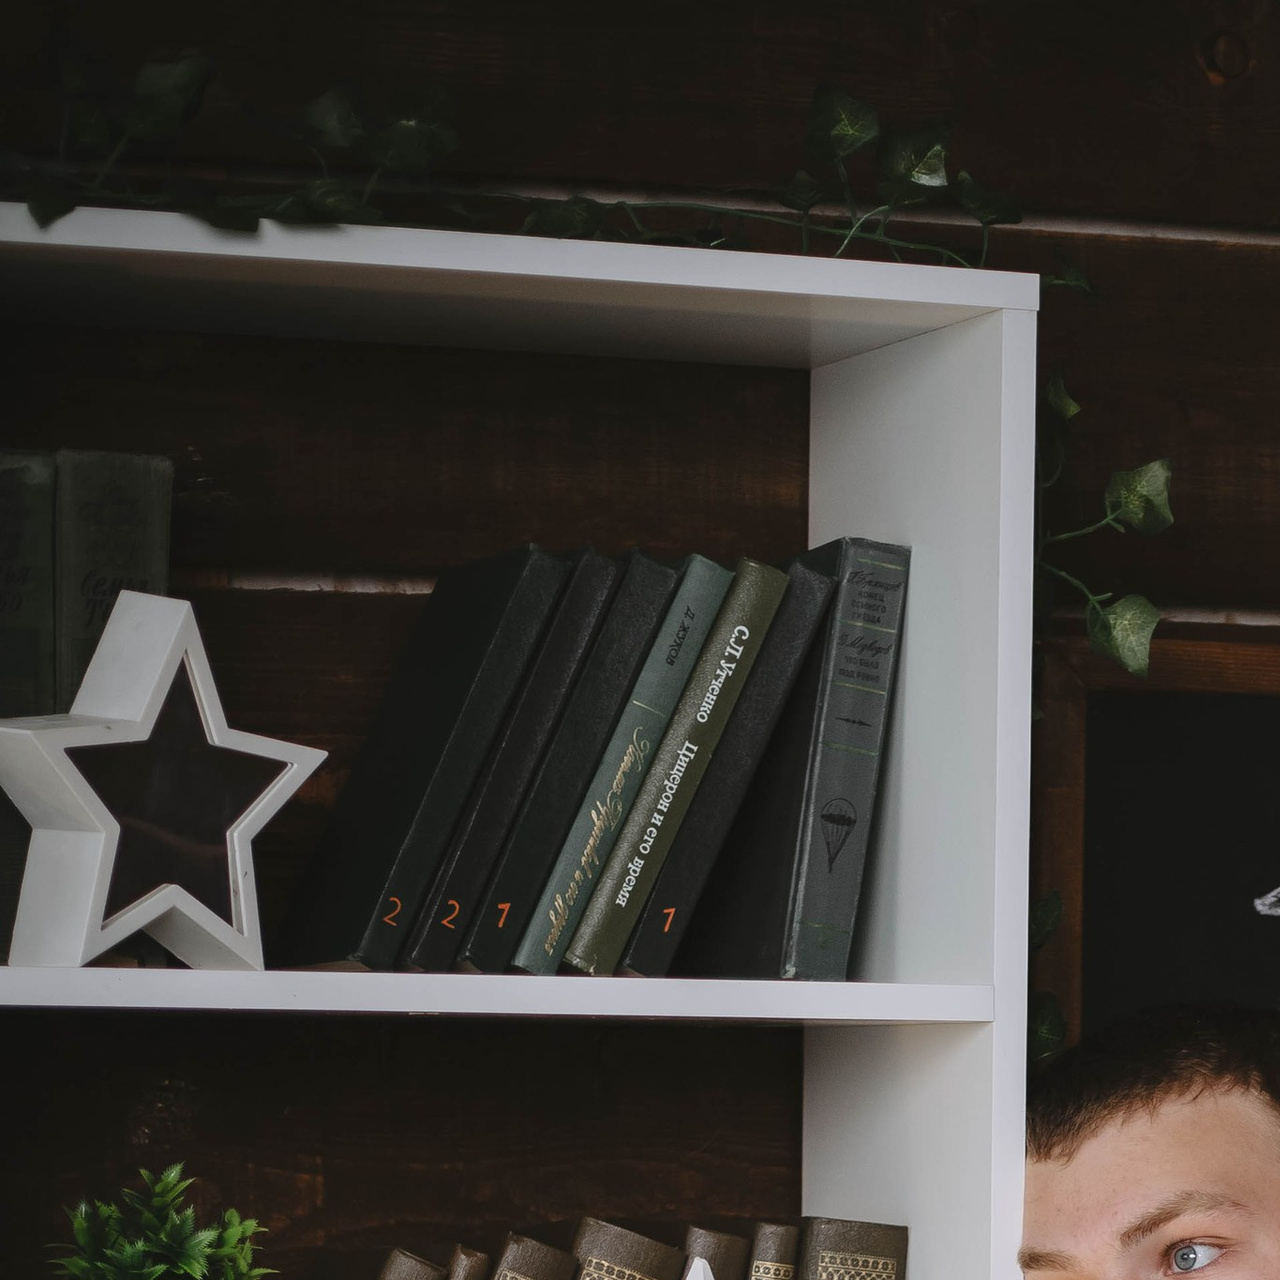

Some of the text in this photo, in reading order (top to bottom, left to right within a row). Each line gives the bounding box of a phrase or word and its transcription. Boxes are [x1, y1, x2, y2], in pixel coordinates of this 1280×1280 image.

[665, 619, 690, 667] ЖУКОВ
[696, 625, 750, 724] С.Л. Утченко
[615, 739, 699, 908] Цицерон и его время
[382, 896, 402, 927] 2
[441, 899, 460, 929] 2
[497, 902, 511, 928] 1
[663, 907, 677, 933] 1
